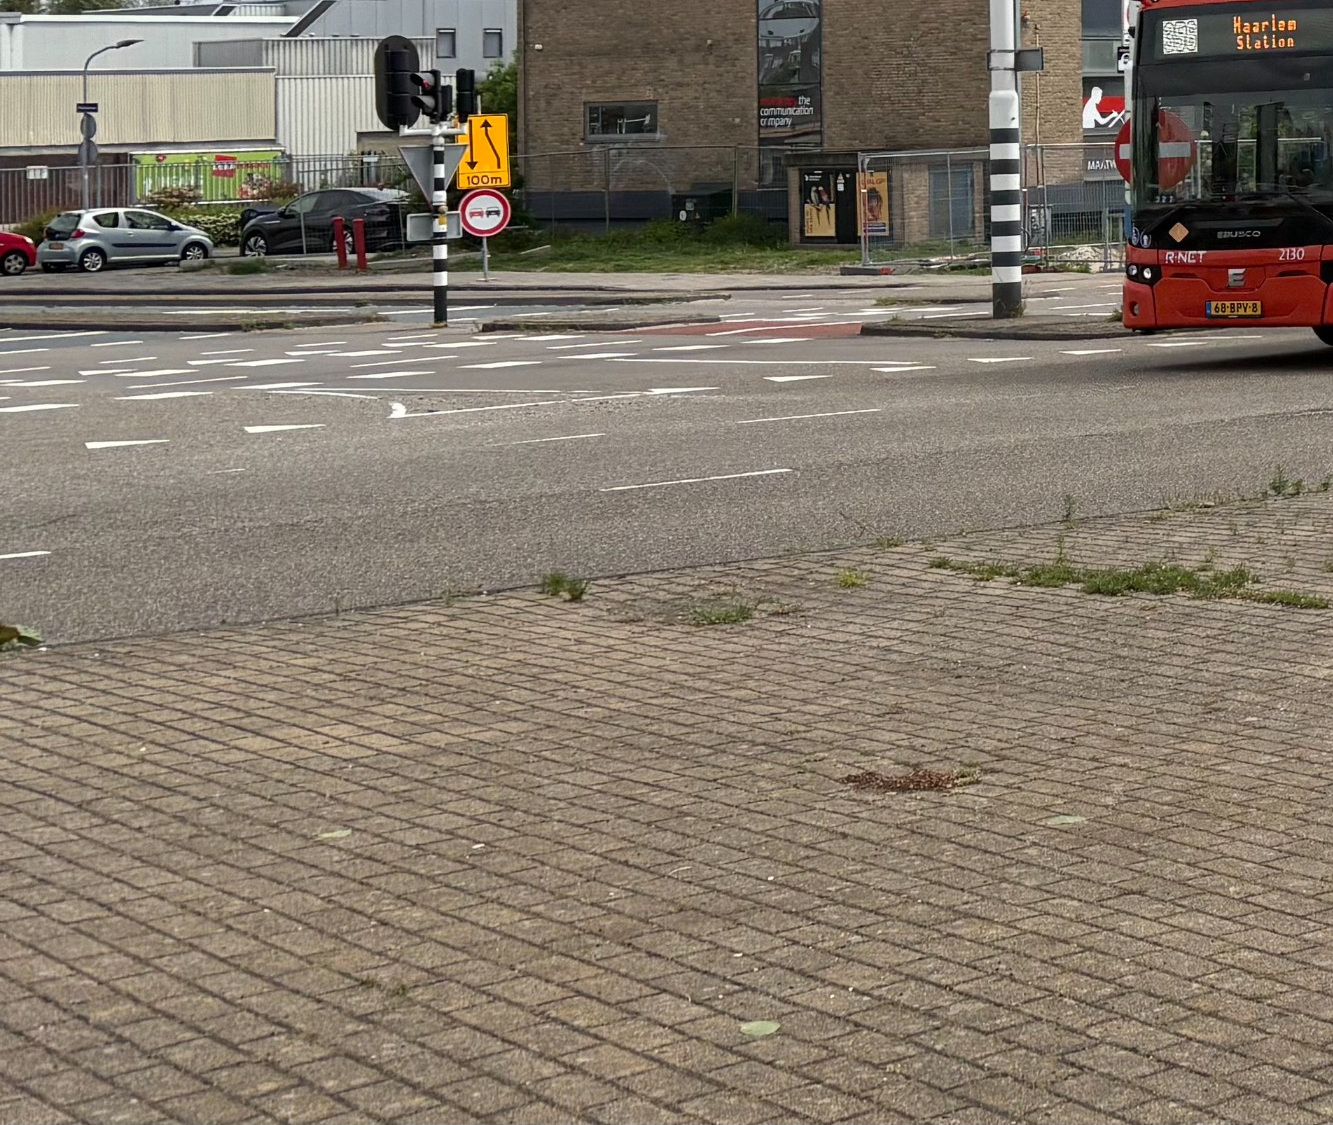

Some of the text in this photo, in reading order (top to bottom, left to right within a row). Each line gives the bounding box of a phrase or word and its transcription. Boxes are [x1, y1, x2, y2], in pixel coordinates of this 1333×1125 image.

[1233, 14, 1297, 34] Haarlem
[1236, 34, 1295, 50] Station
[798, 95, 811, 105] the
[760, 106, 814, 116] communication
[467, 174, 503, 186] 100m
[1216, 230, 1262, 239] EBUSCO
[1278, 248, 1306, 261] 2130
